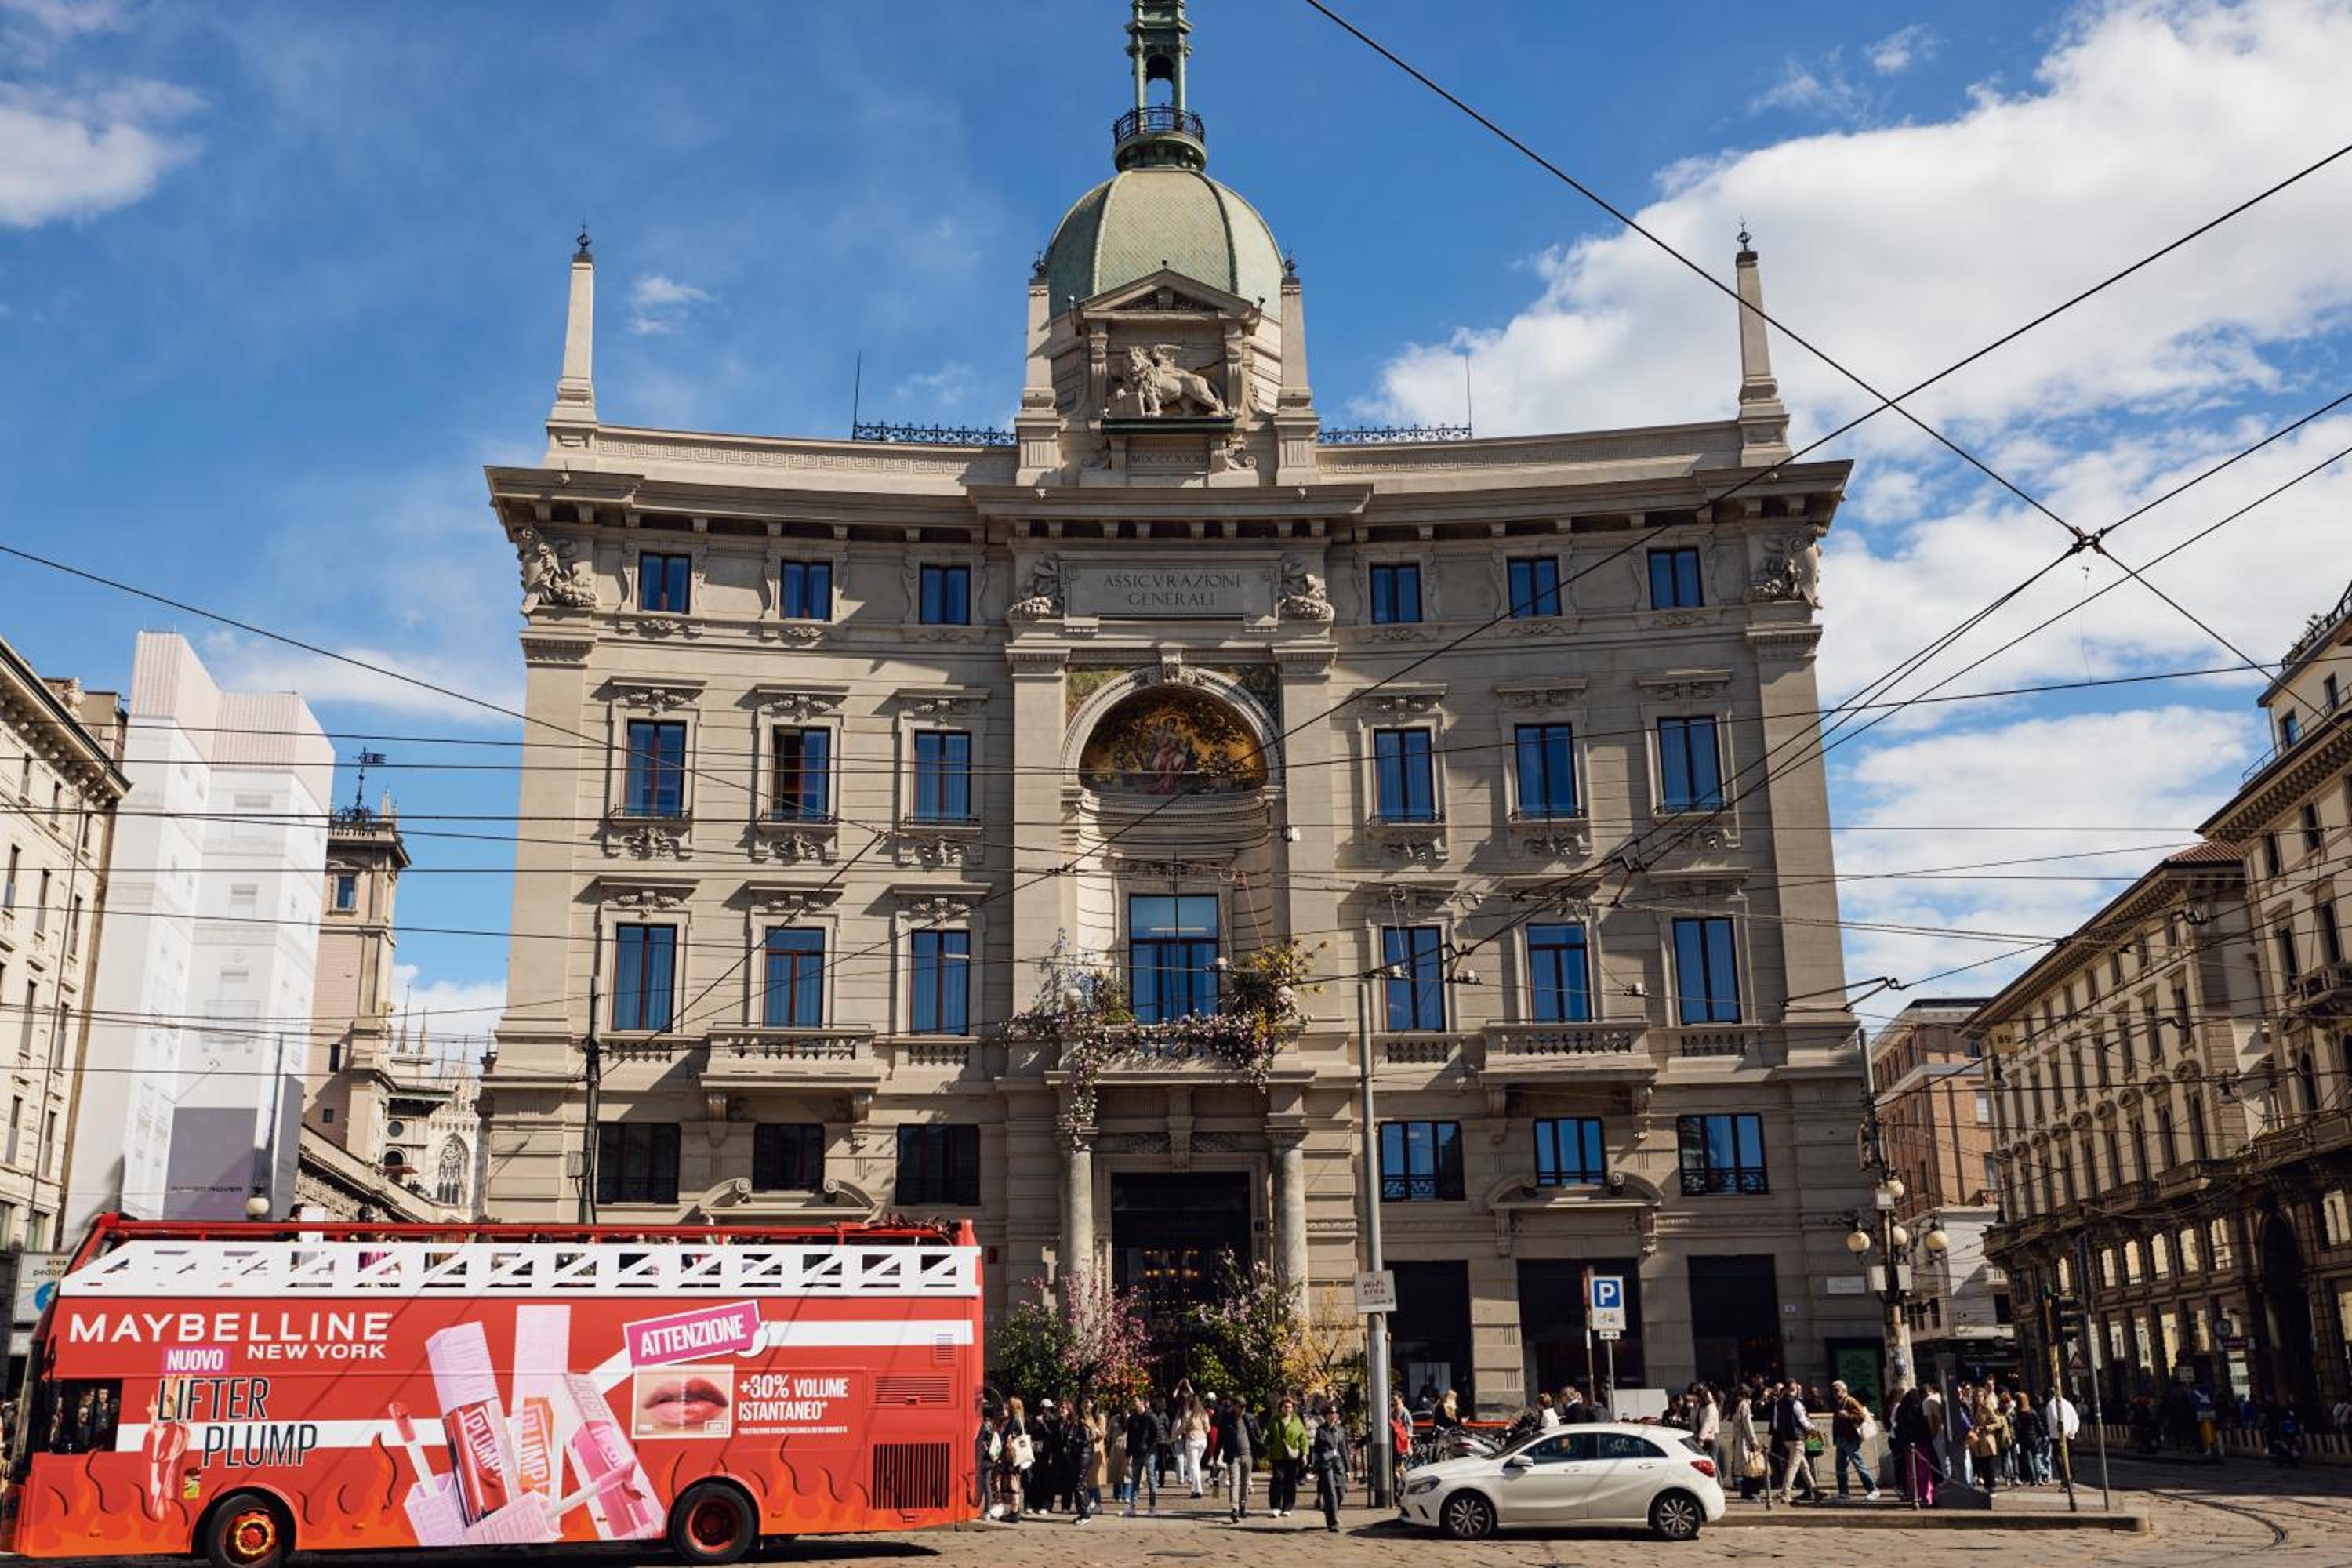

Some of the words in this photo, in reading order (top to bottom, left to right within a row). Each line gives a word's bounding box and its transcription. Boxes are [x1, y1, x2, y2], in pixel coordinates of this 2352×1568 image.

[1104, 573, 1240, 587] ASSICVRAZIONI
[1128, 592, 1215, 606] GENERALI
[1599, 1282, 1615, 1305] P
[69, 1312, 393, 1343] MAYBELLINE
[641, 1313, 747, 1358] ATTENZIONE
[167, 1348, 224, 1371] NUOVO
[247, 1344, 308, 1359] NEW
[315, 1343, 387, 1359] YORK
[739, 1374, 789, 1398] +30%
[793, 1377, 849, 1398] VOLUME
[157, 1377, 270, 1422] LIFTER
[202, 1424, 318, 1468] PLUMP
